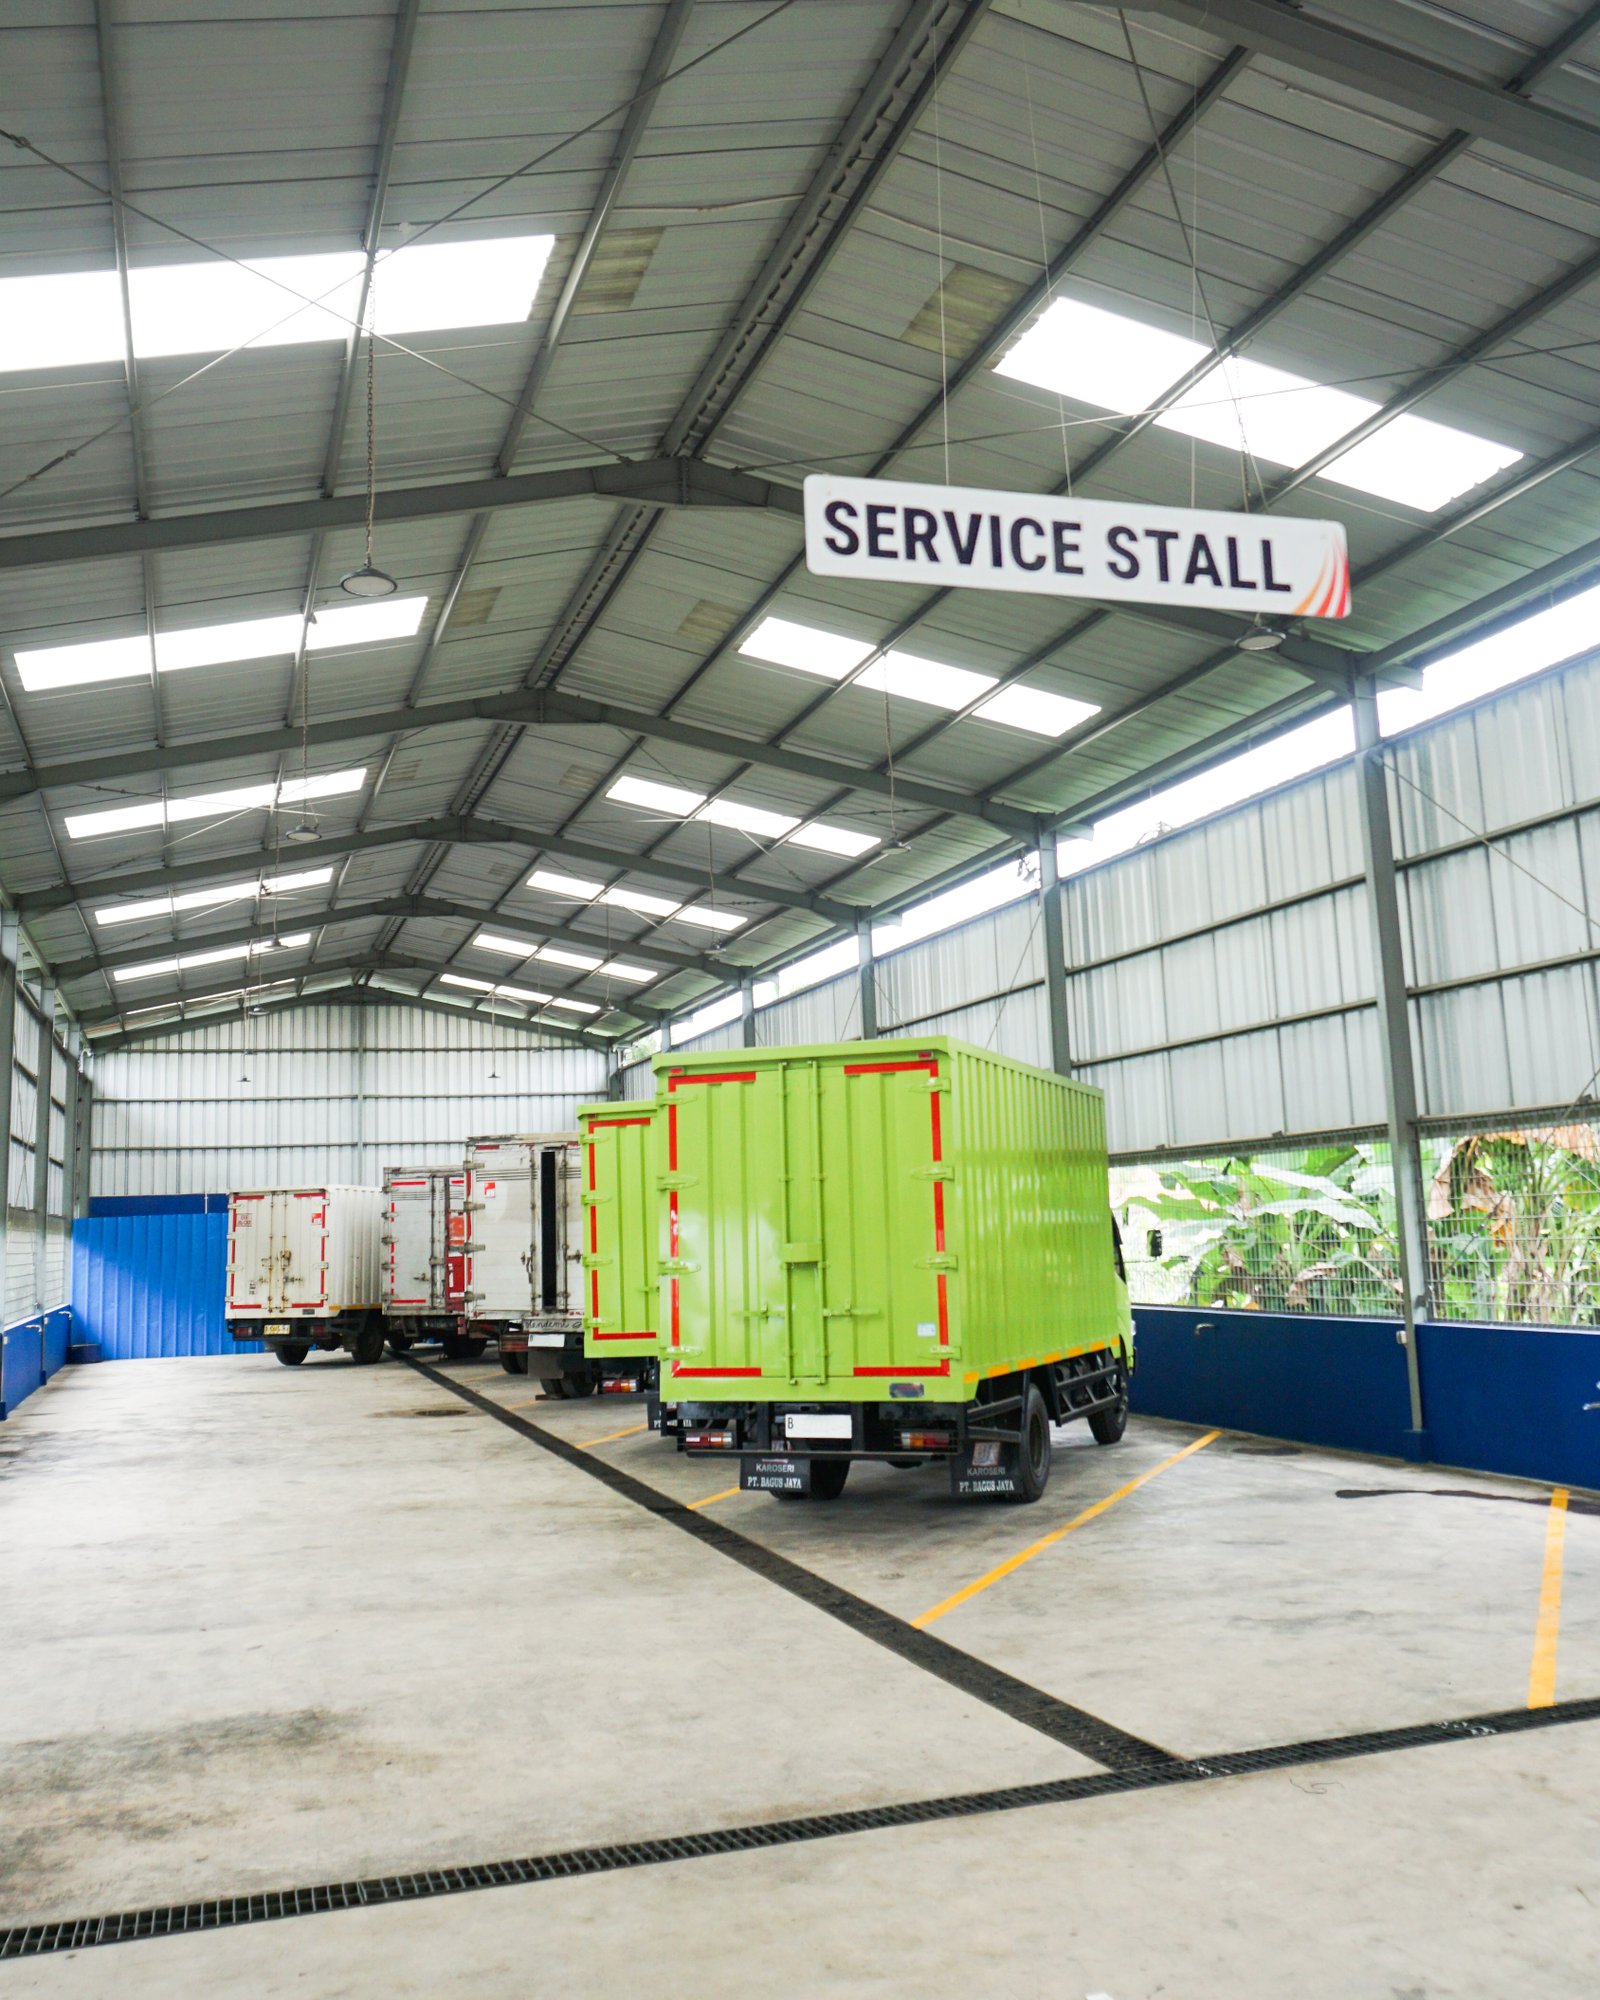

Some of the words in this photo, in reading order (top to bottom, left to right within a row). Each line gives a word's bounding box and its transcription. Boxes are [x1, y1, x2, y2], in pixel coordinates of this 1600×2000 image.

[824, 500, 1084, 575] SERVICE
[1106, 525, 1292, 592] STALL
[787, 1417, 794, 1429] B
[756, 1464, 795, 1473] KAROSERI
[966, 1466, 1006, 1476] KAROSERI
[747, 1476, 759, 1487] PT.
[760, 1477, 783, 1488] BAGUS
[784, 1478, 802, 1489] JAYA
[959, 1481, 971, 1492] PT.
[972, 1481, 996, 1492] BAGUS
[996, 1480, 1015, 1491] JAYA
